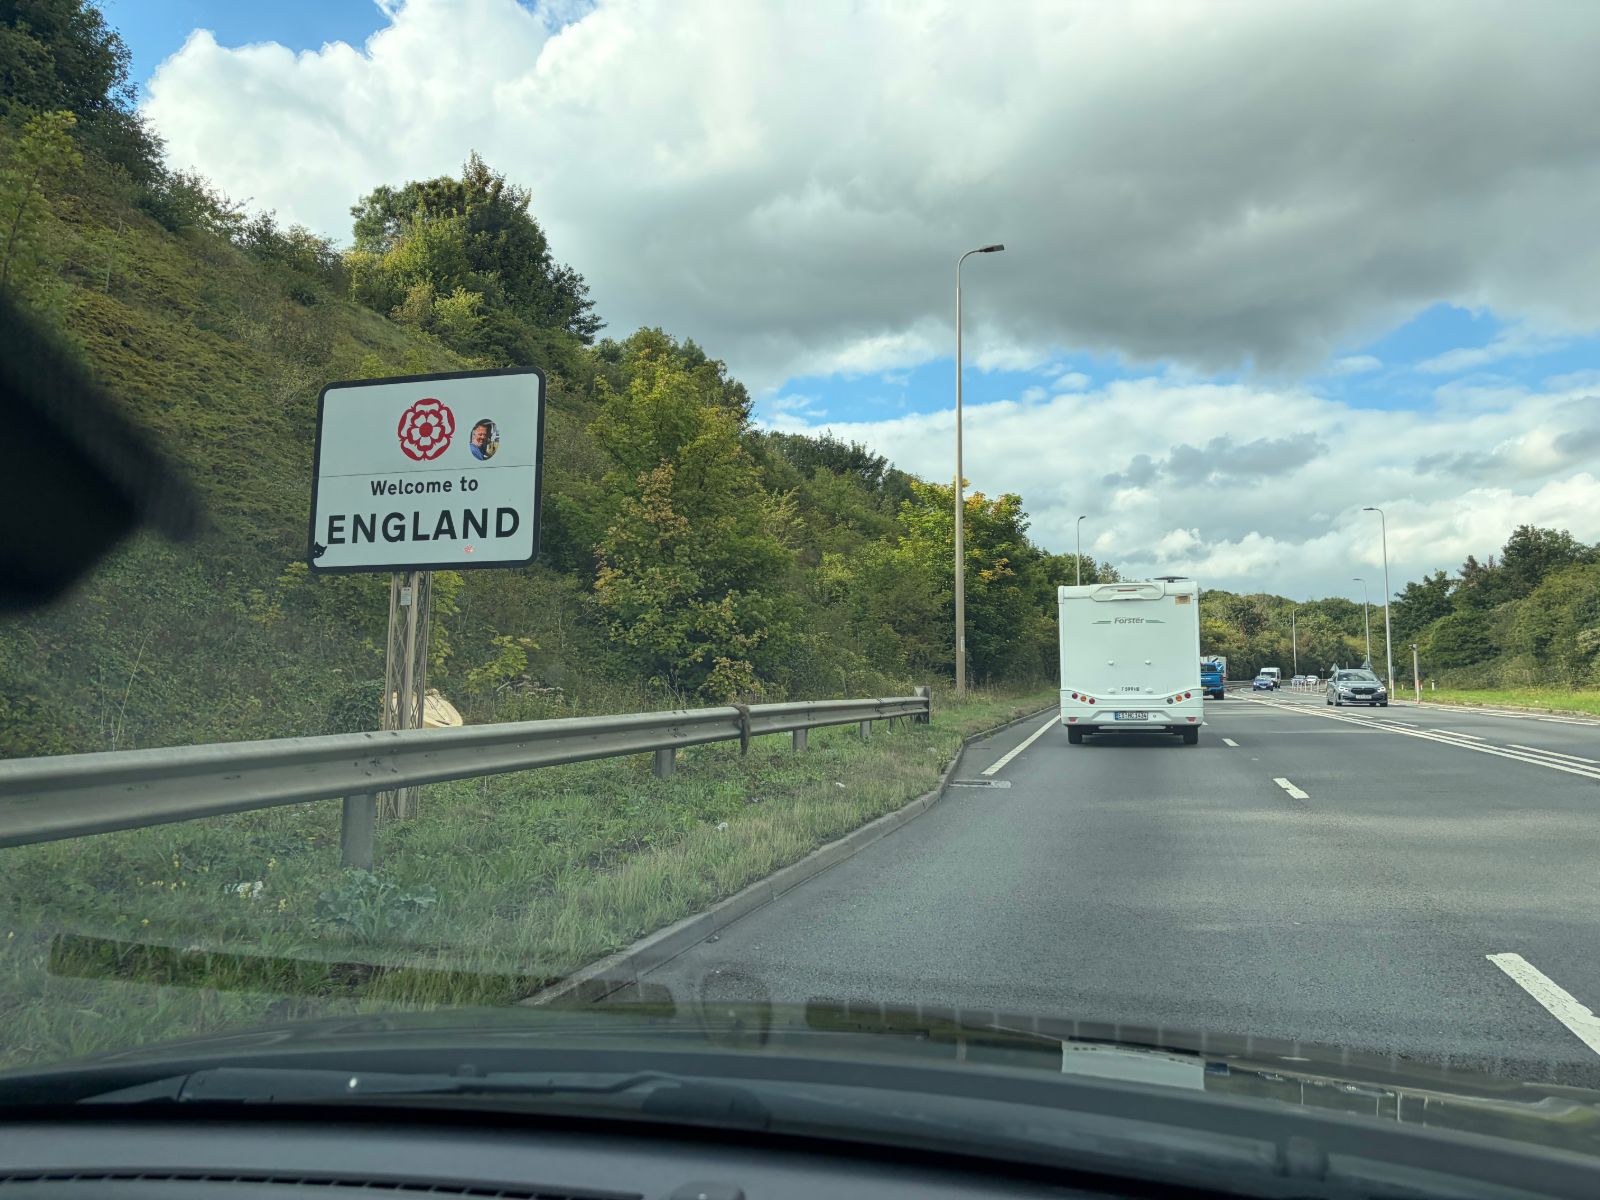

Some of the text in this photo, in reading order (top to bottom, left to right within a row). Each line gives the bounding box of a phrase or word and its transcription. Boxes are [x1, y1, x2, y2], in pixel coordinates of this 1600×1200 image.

[370, 476, 479, 496] Welcome to
[327, 507, 520, 545] ENGLAND
